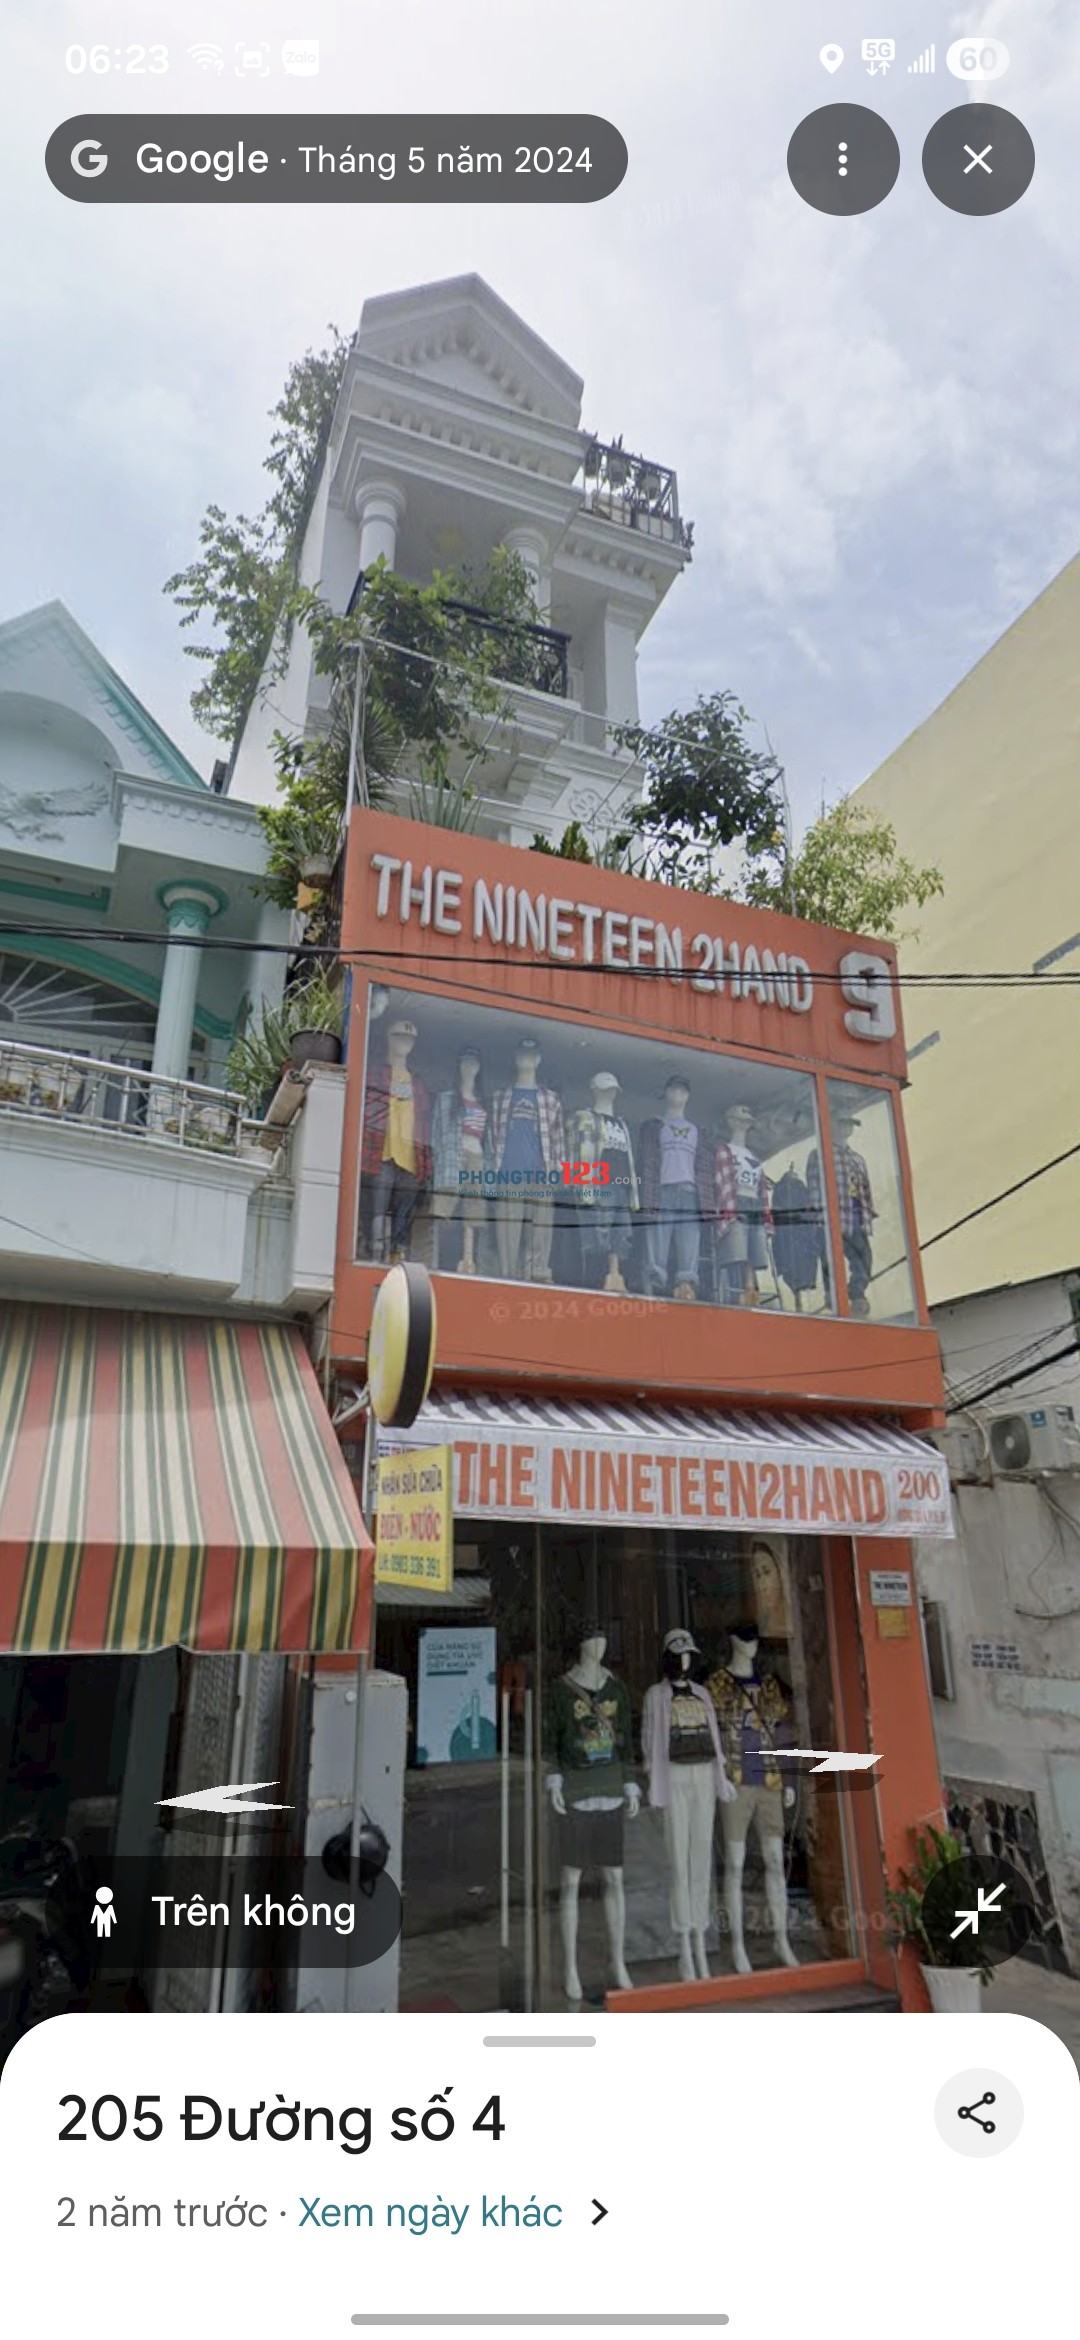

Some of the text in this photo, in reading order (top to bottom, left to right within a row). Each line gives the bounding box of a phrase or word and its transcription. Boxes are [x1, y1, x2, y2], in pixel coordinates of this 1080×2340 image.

[370, 853, 815, 1014] THE NINETEEN 2HAND
[839, 950, 897, 1043] 9
[454, 1440, 887, 1525] THE NINETEEN2HAND
[897, 1469, 941, 1501] 200
